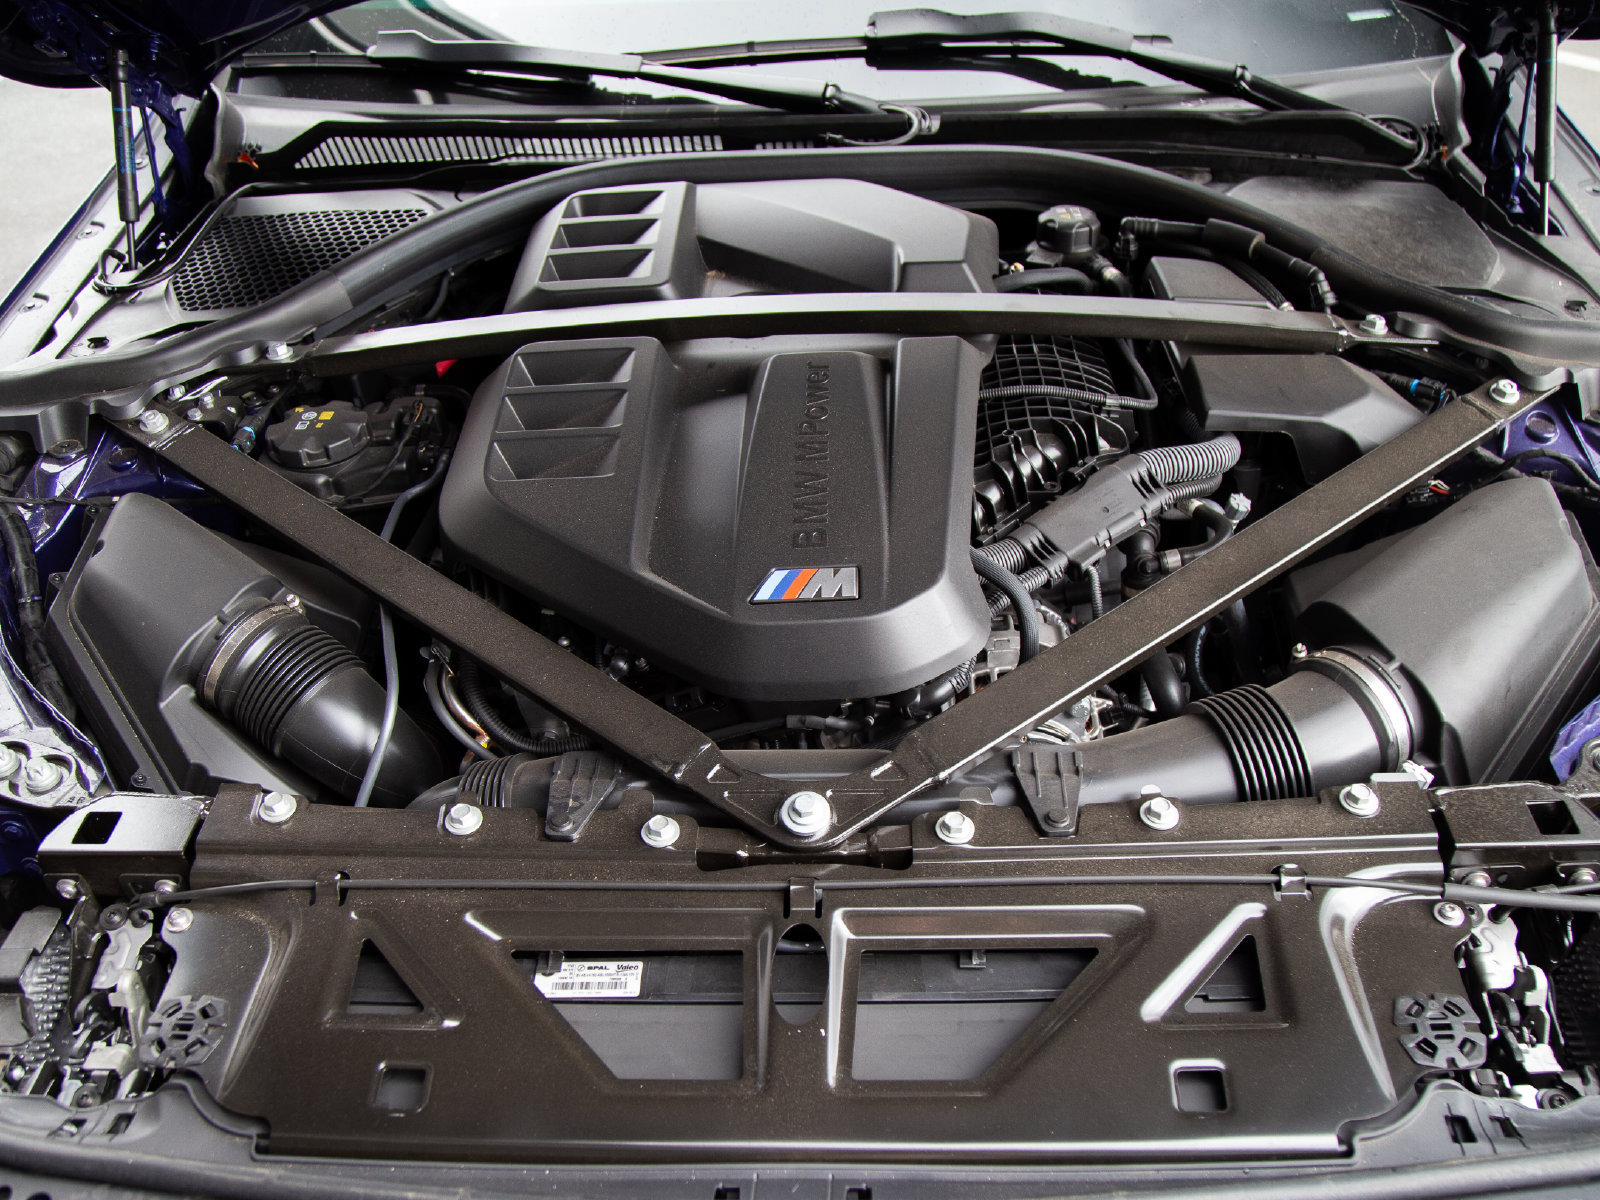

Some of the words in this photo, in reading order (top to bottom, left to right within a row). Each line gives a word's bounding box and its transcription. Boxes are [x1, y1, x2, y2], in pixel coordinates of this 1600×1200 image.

[793, 471, 829, 548] BMW
[798, 567, 858, 599] M
[616, 964, 639, 972] Valeo
